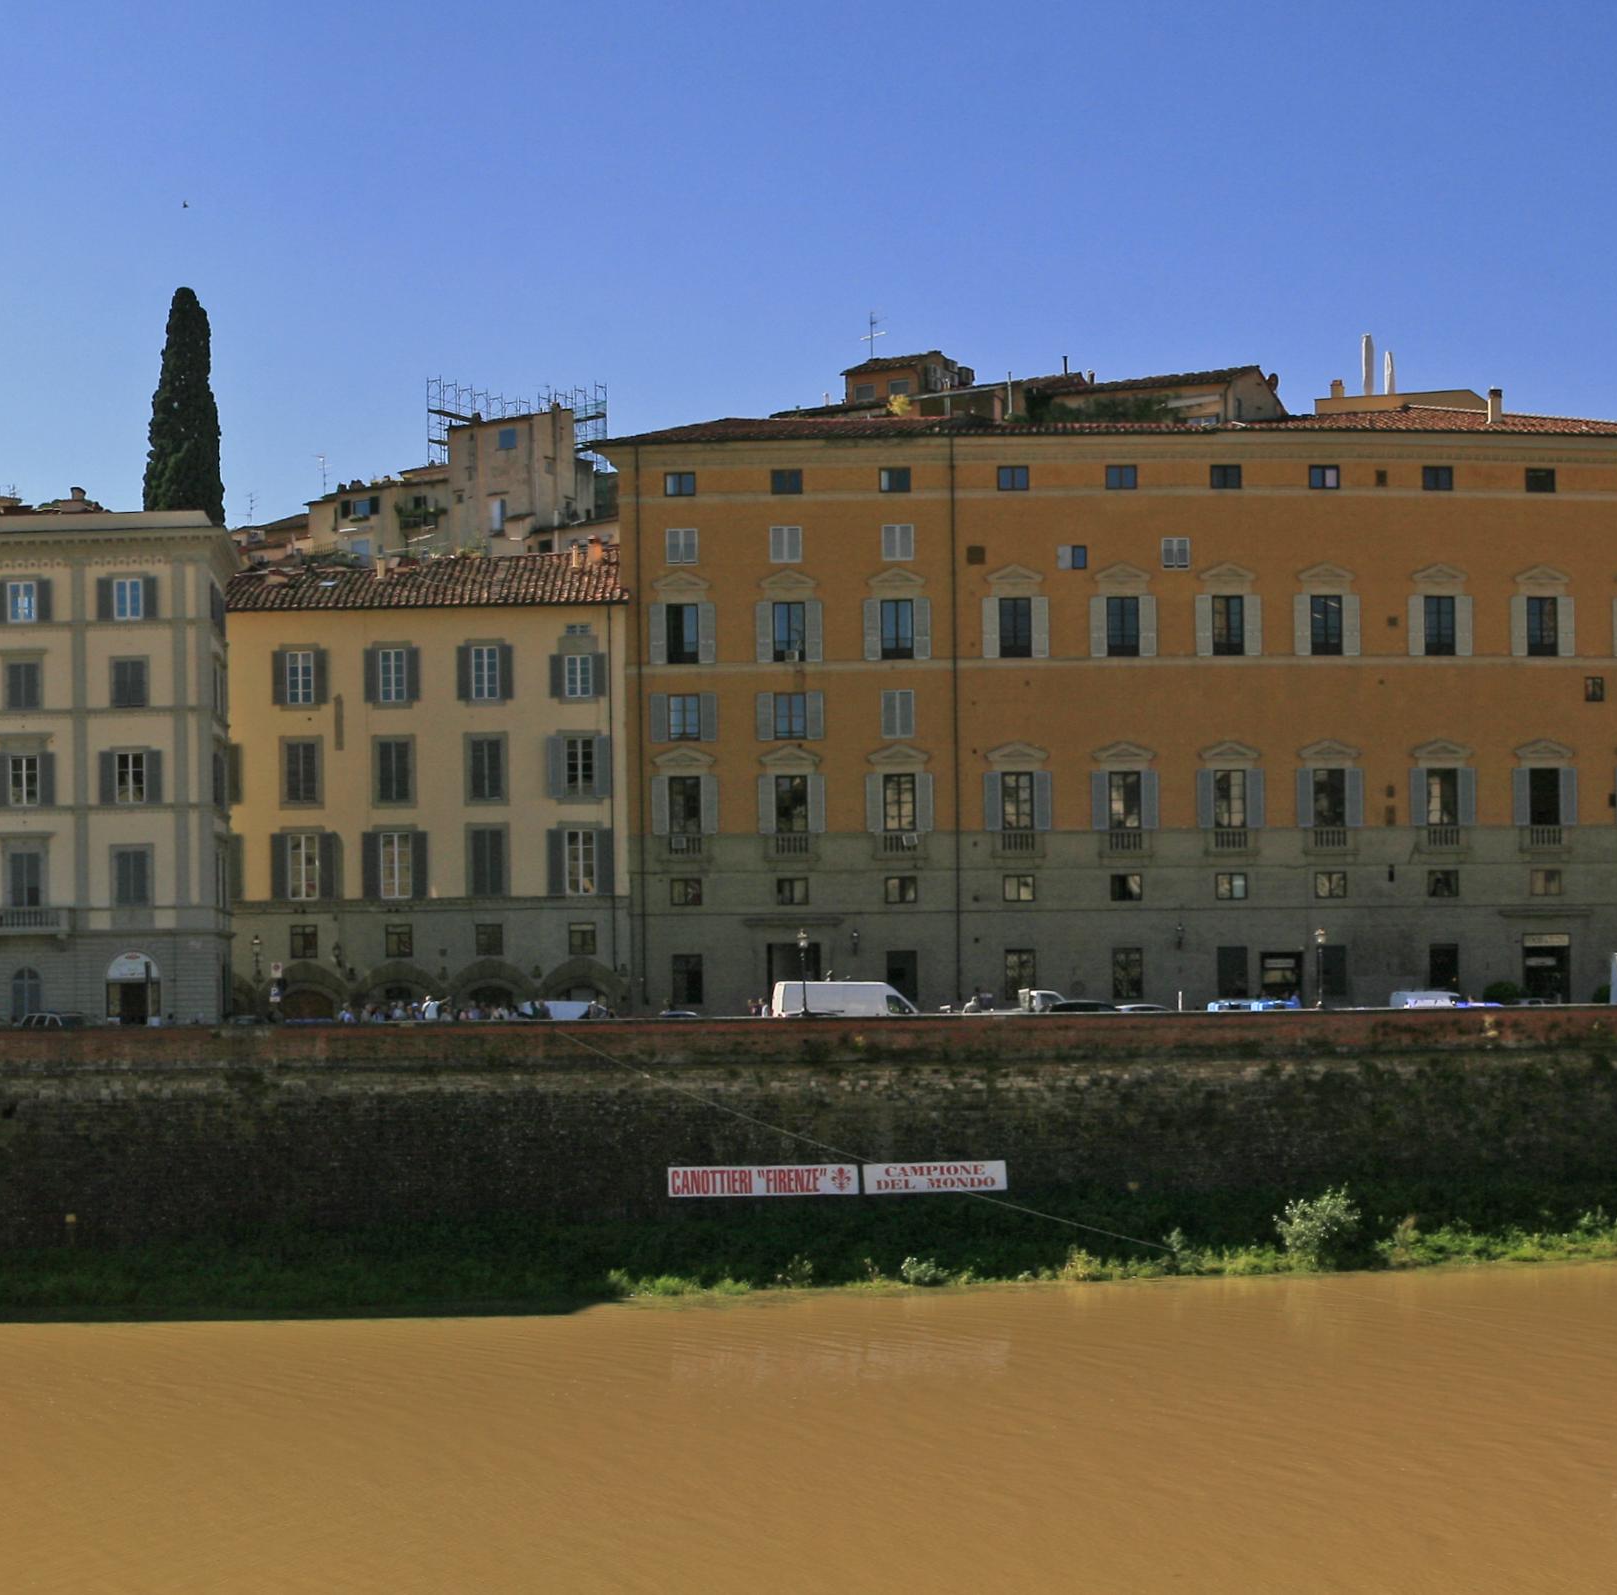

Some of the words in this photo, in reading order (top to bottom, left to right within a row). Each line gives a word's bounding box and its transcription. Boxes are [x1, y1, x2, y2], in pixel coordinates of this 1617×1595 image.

[885, 1164, 985, 1177] CAMPIONE
[671, 1169, 753, 1195] CANOTTIERI
[758, 1168, 828, 1193] "FIRENZE"
[876, 1179, 916, 1190] DEL
[927, 1176, 996, 1189] MONDO
